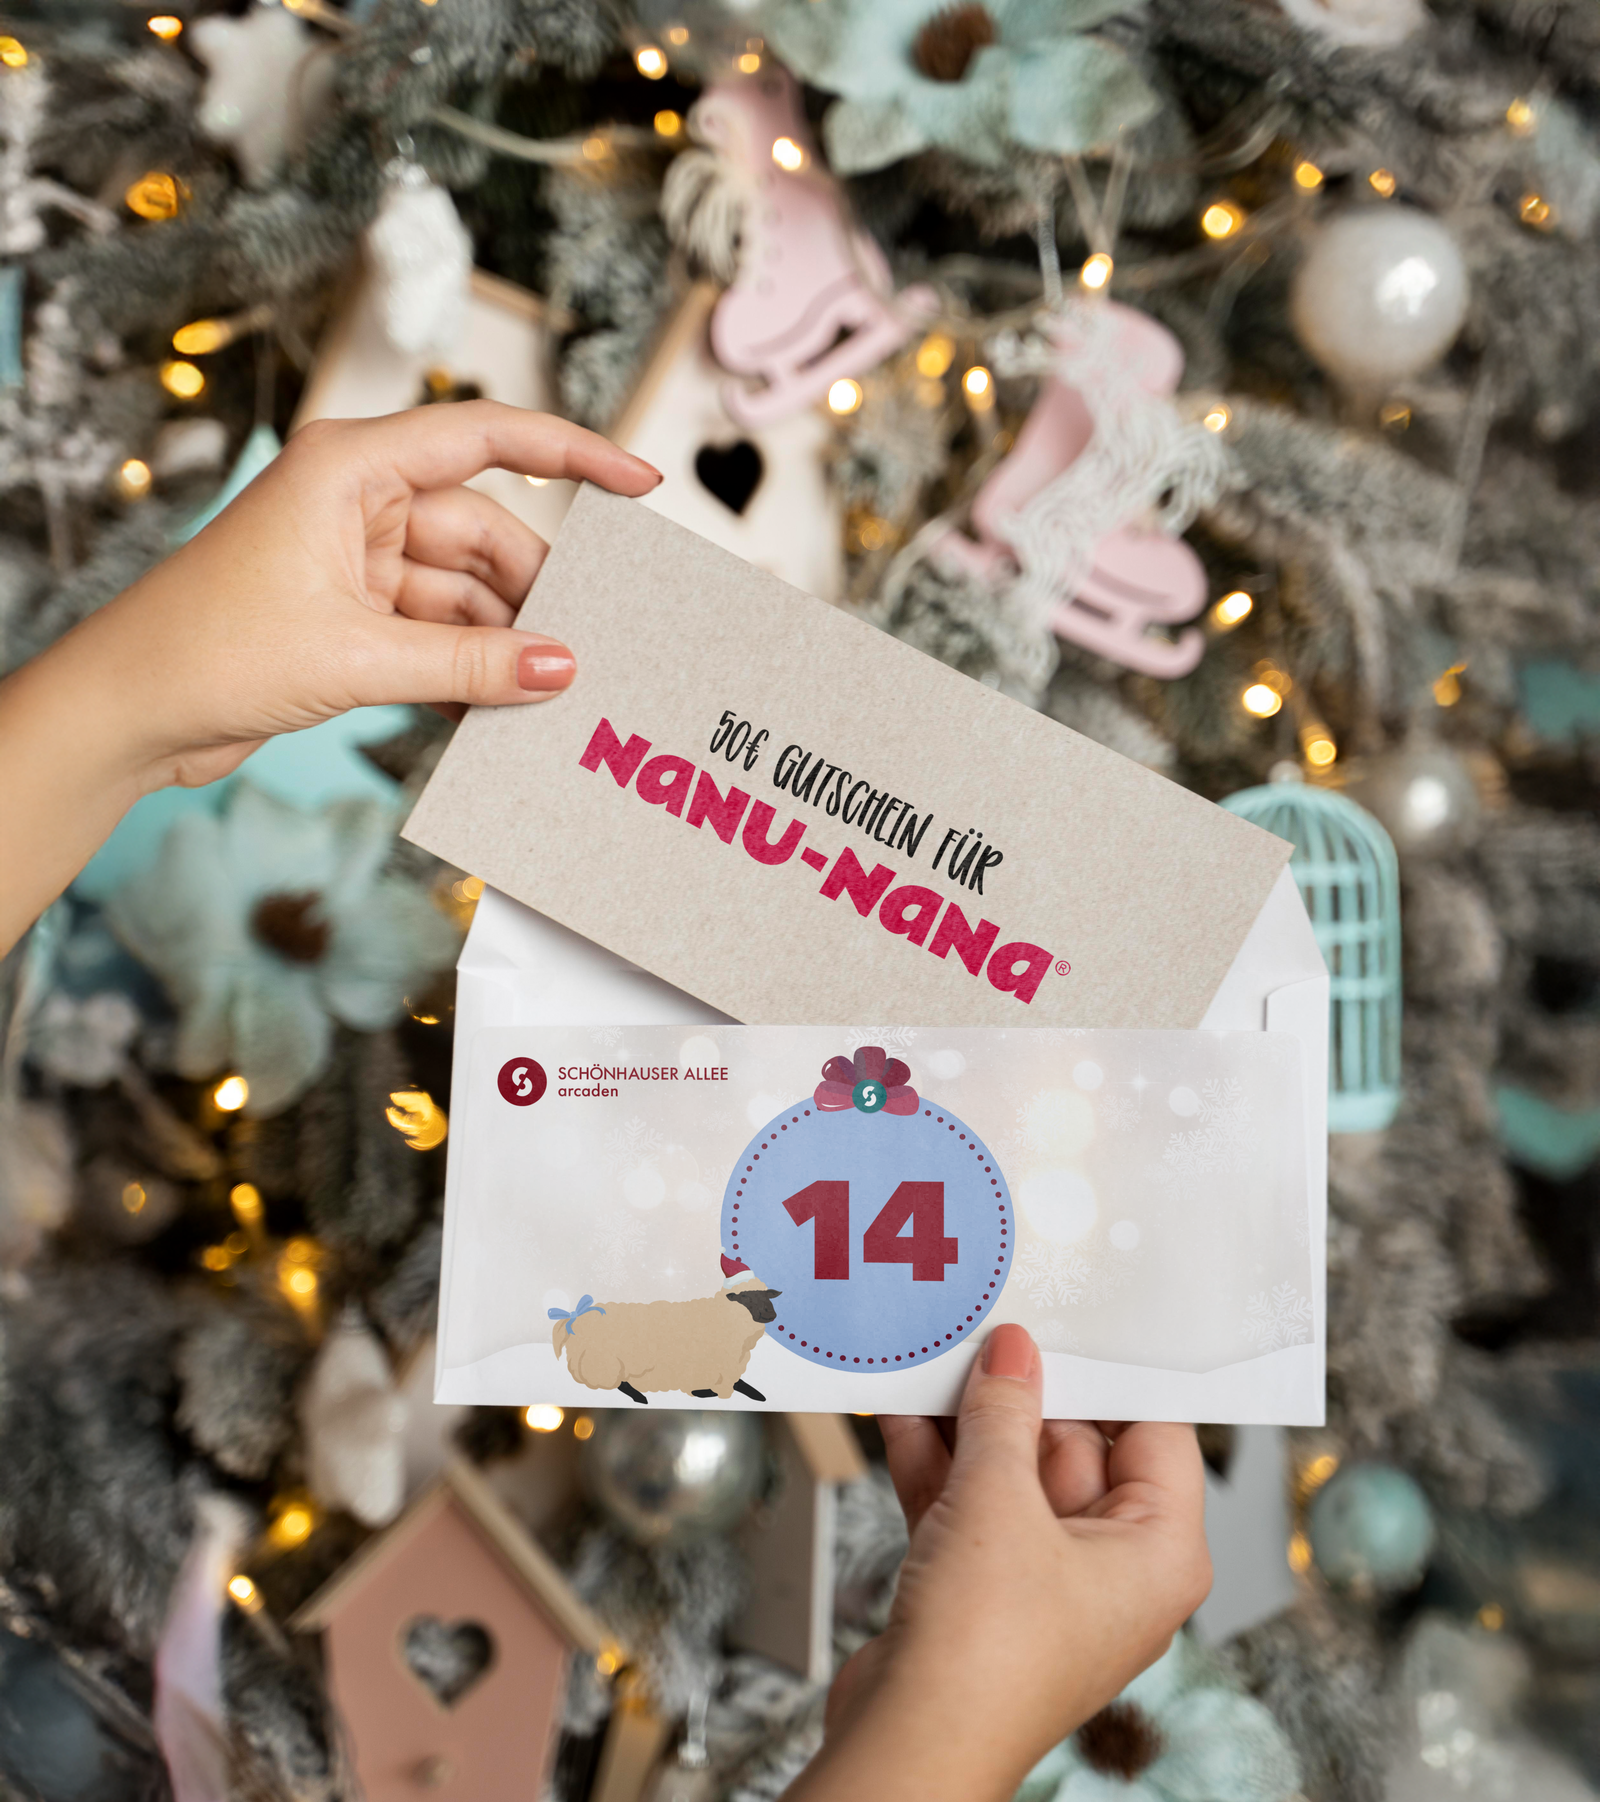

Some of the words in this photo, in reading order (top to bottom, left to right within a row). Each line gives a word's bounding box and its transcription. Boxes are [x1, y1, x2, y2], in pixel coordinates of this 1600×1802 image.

[709, 710, 770, 772] 50€
[773, 744, 934, 858] GUTSCHEIN
[931, 827, 1004, 896] FÜR
[557, 1063, 679, 1081] SCHÖNHAUSER
[683, 1066, 729, 1081] ALLEE
[557, 1082, 619, 1098] arcaden
[781, 1180, 959, 1282] 14
